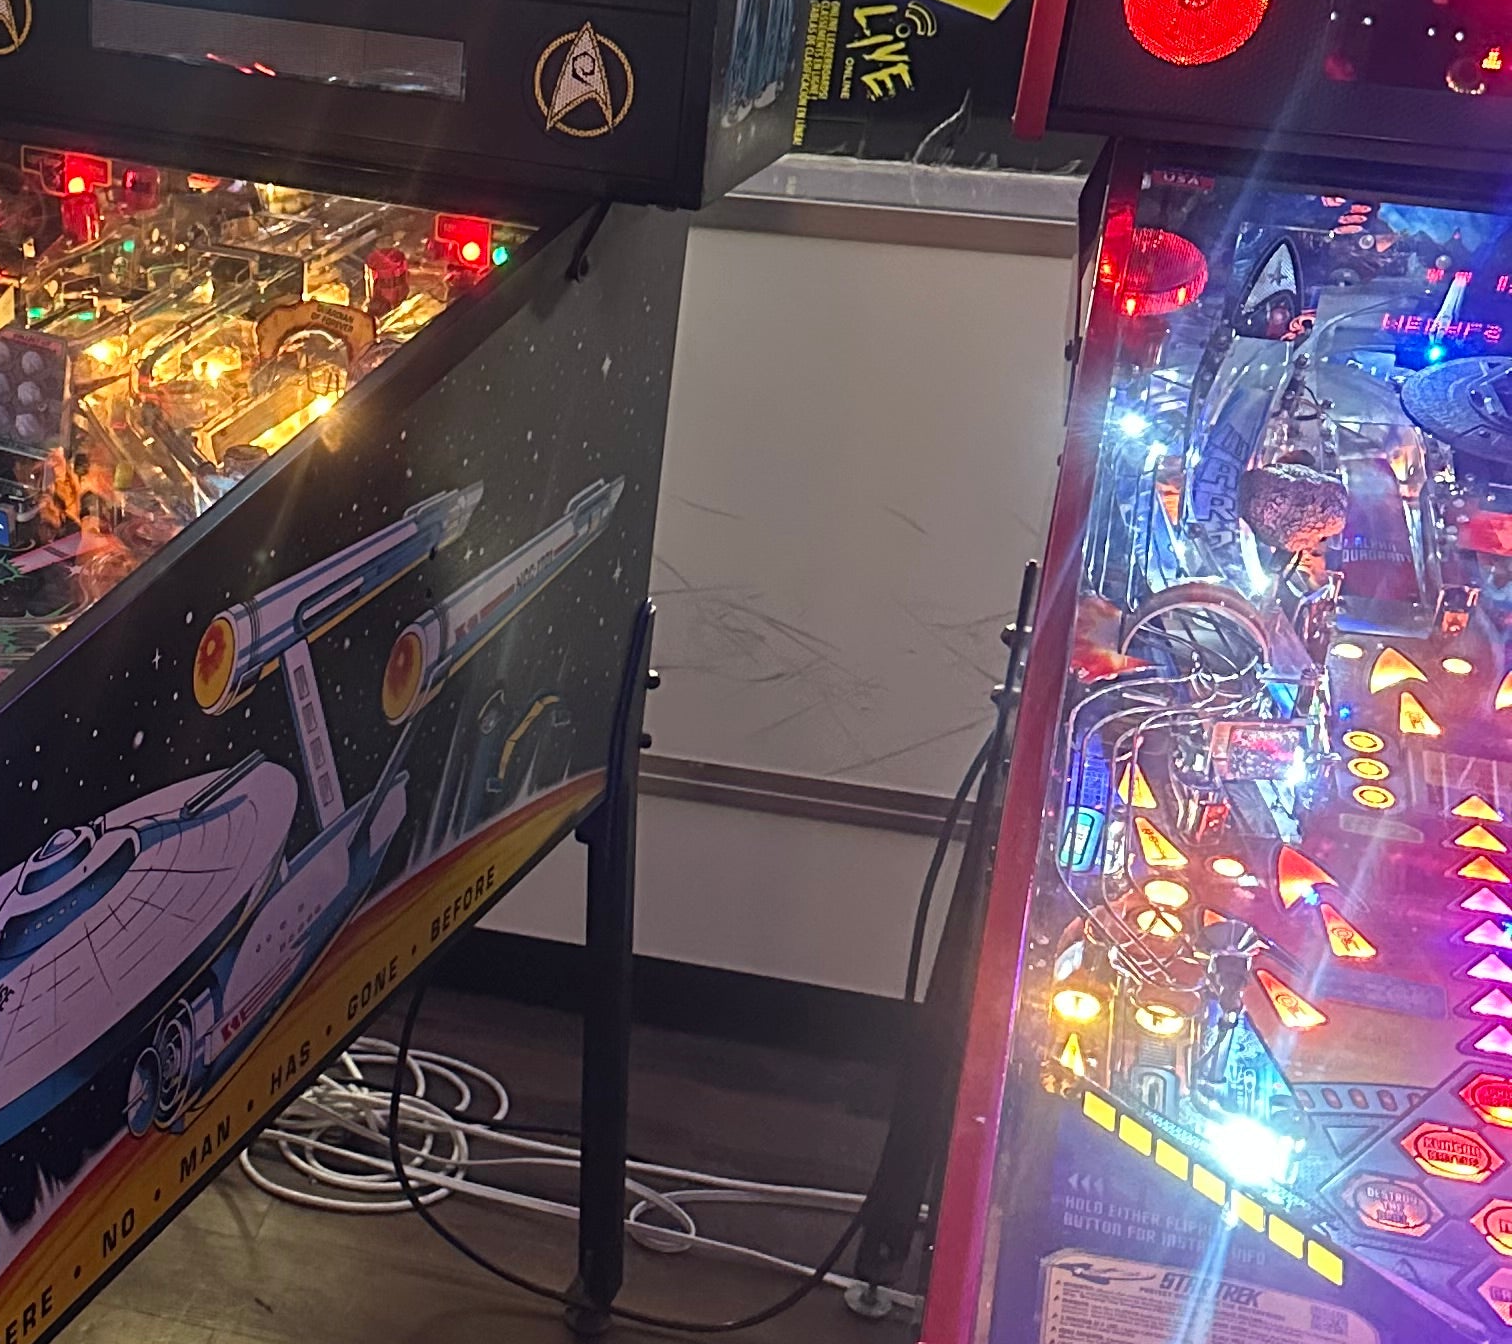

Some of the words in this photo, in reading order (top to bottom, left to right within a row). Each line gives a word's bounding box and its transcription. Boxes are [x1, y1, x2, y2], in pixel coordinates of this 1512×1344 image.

[845, 3, 915, 102] LIVE
[840, 56, 855, 100] ONLINE
[101, 1207, 136, 1258] NO
[179, 1115, 232, 1183] MAN
[269, 1040, 312, 1096] HAS
[346, 955, 399, 1022] GONE
[429, 864, 496, 942] BEFORE
[1063, 1211, 1122, 1237] BUTTON
[1127, 1223, 1156, 1244] FOR
[1065, 1194, 1103, 1216] HOLD
[1108, 1202, 1160, 1227] EITHER
[1166, 1214, 1221, 1237] FLIPP
[1158, 1271, 1210, 1294] STAR
[1216, 1278, 1263, 1307] TREK
